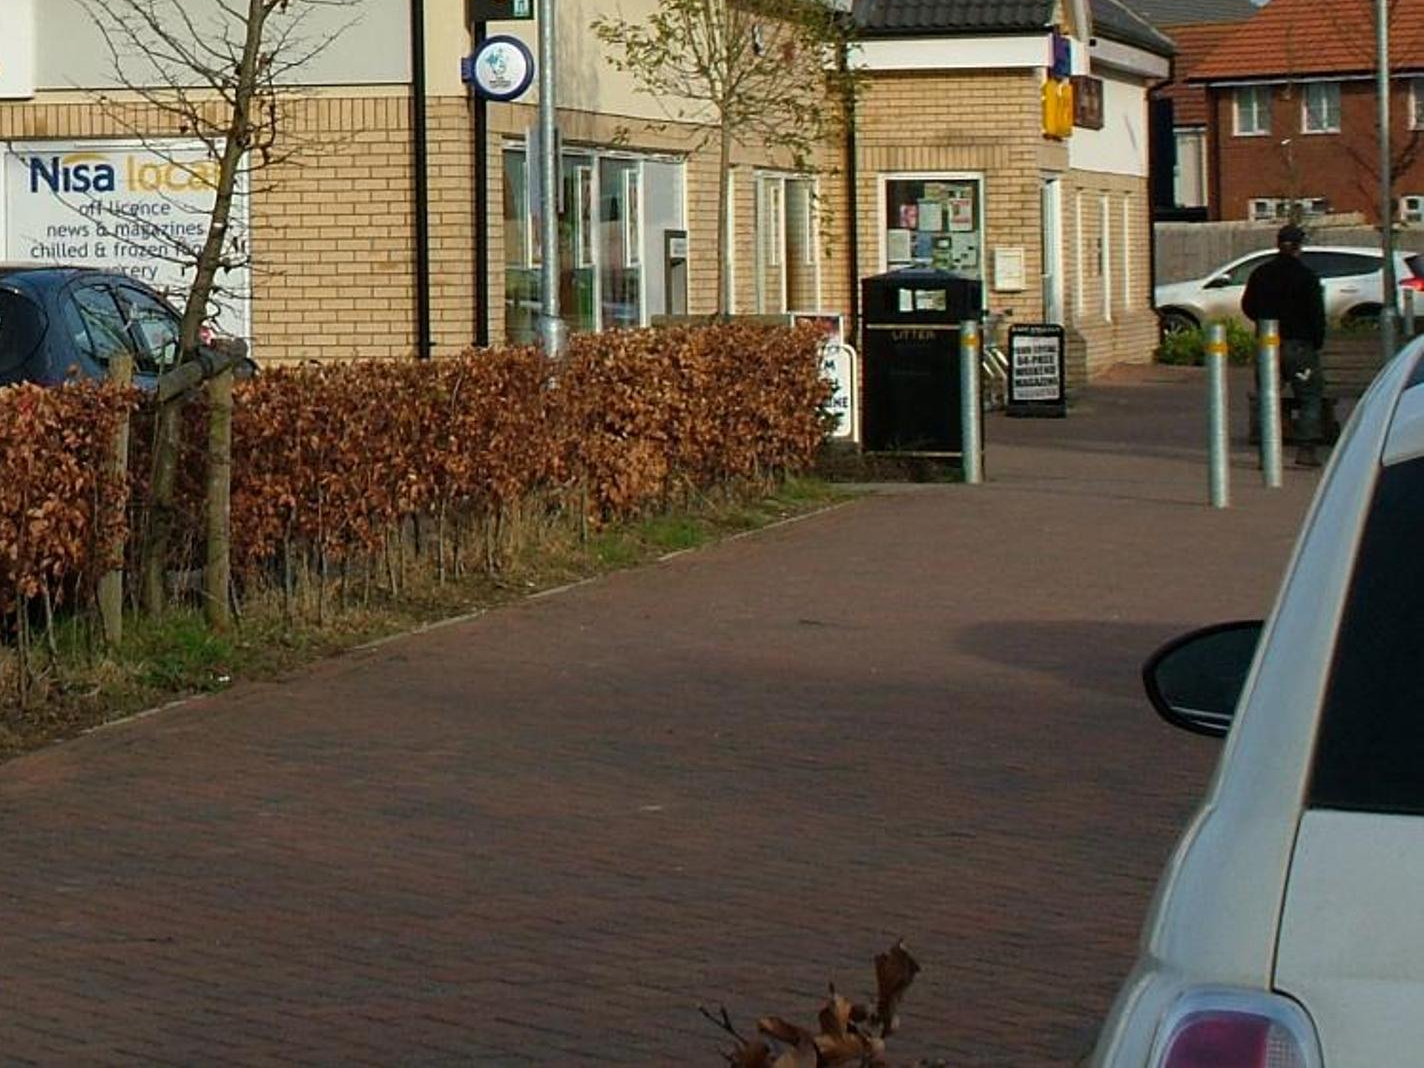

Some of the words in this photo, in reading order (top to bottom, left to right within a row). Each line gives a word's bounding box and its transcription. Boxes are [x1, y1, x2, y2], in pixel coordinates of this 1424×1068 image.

[29, 154, 115, 193] Nisa
[79, 200, 102, 216] off
[109, 200, 172, 216] licence
[47, 224, 90, 237] news
[115, 221, 205, 240] magazines
[30, 242, 88, 258] chilled
[95, 242, 107, 258] &
[113, 241, 169, 258] frozen
